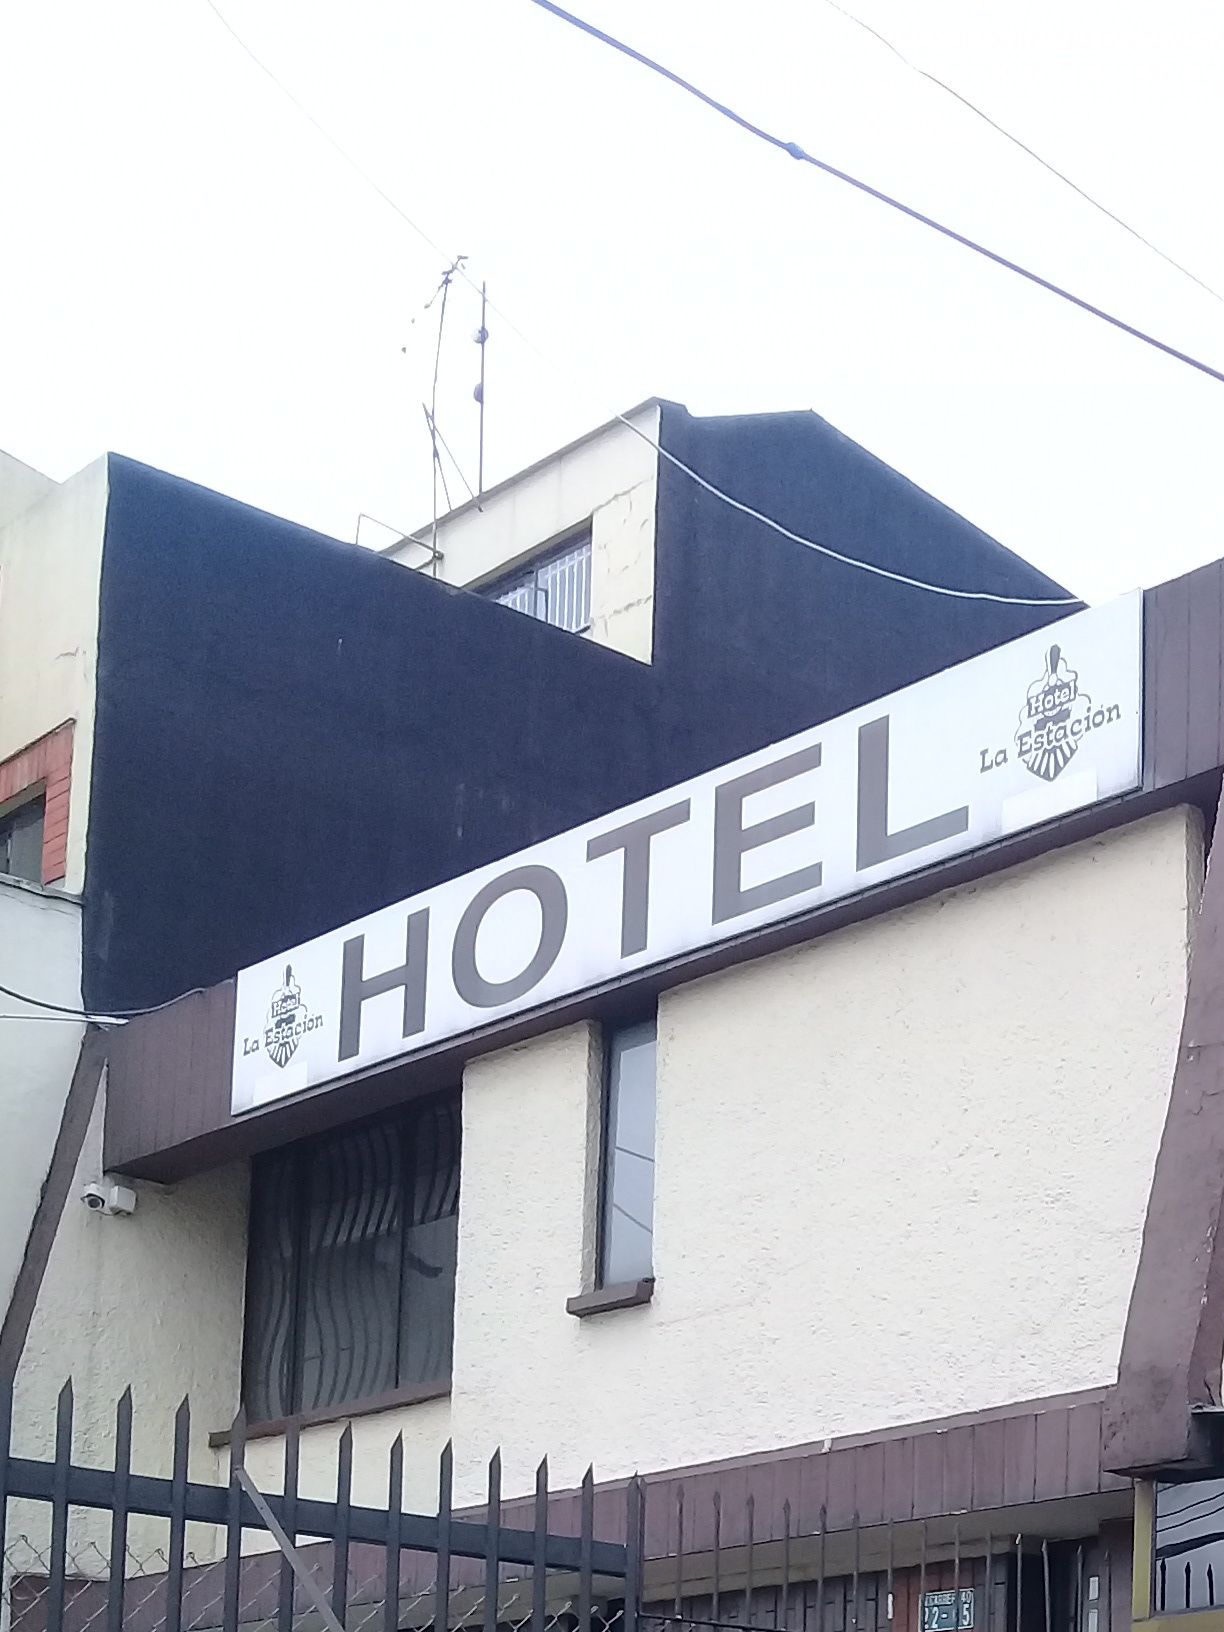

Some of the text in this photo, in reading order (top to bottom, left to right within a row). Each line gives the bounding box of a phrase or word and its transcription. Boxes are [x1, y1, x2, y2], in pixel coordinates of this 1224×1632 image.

[1030, 680, 1076, 717] Hotel
[980, 702, 1122, 774] La Estación
[337, 714, 970, 1062] HOTEL
[243, 1014, 324, 1057] La Estación
